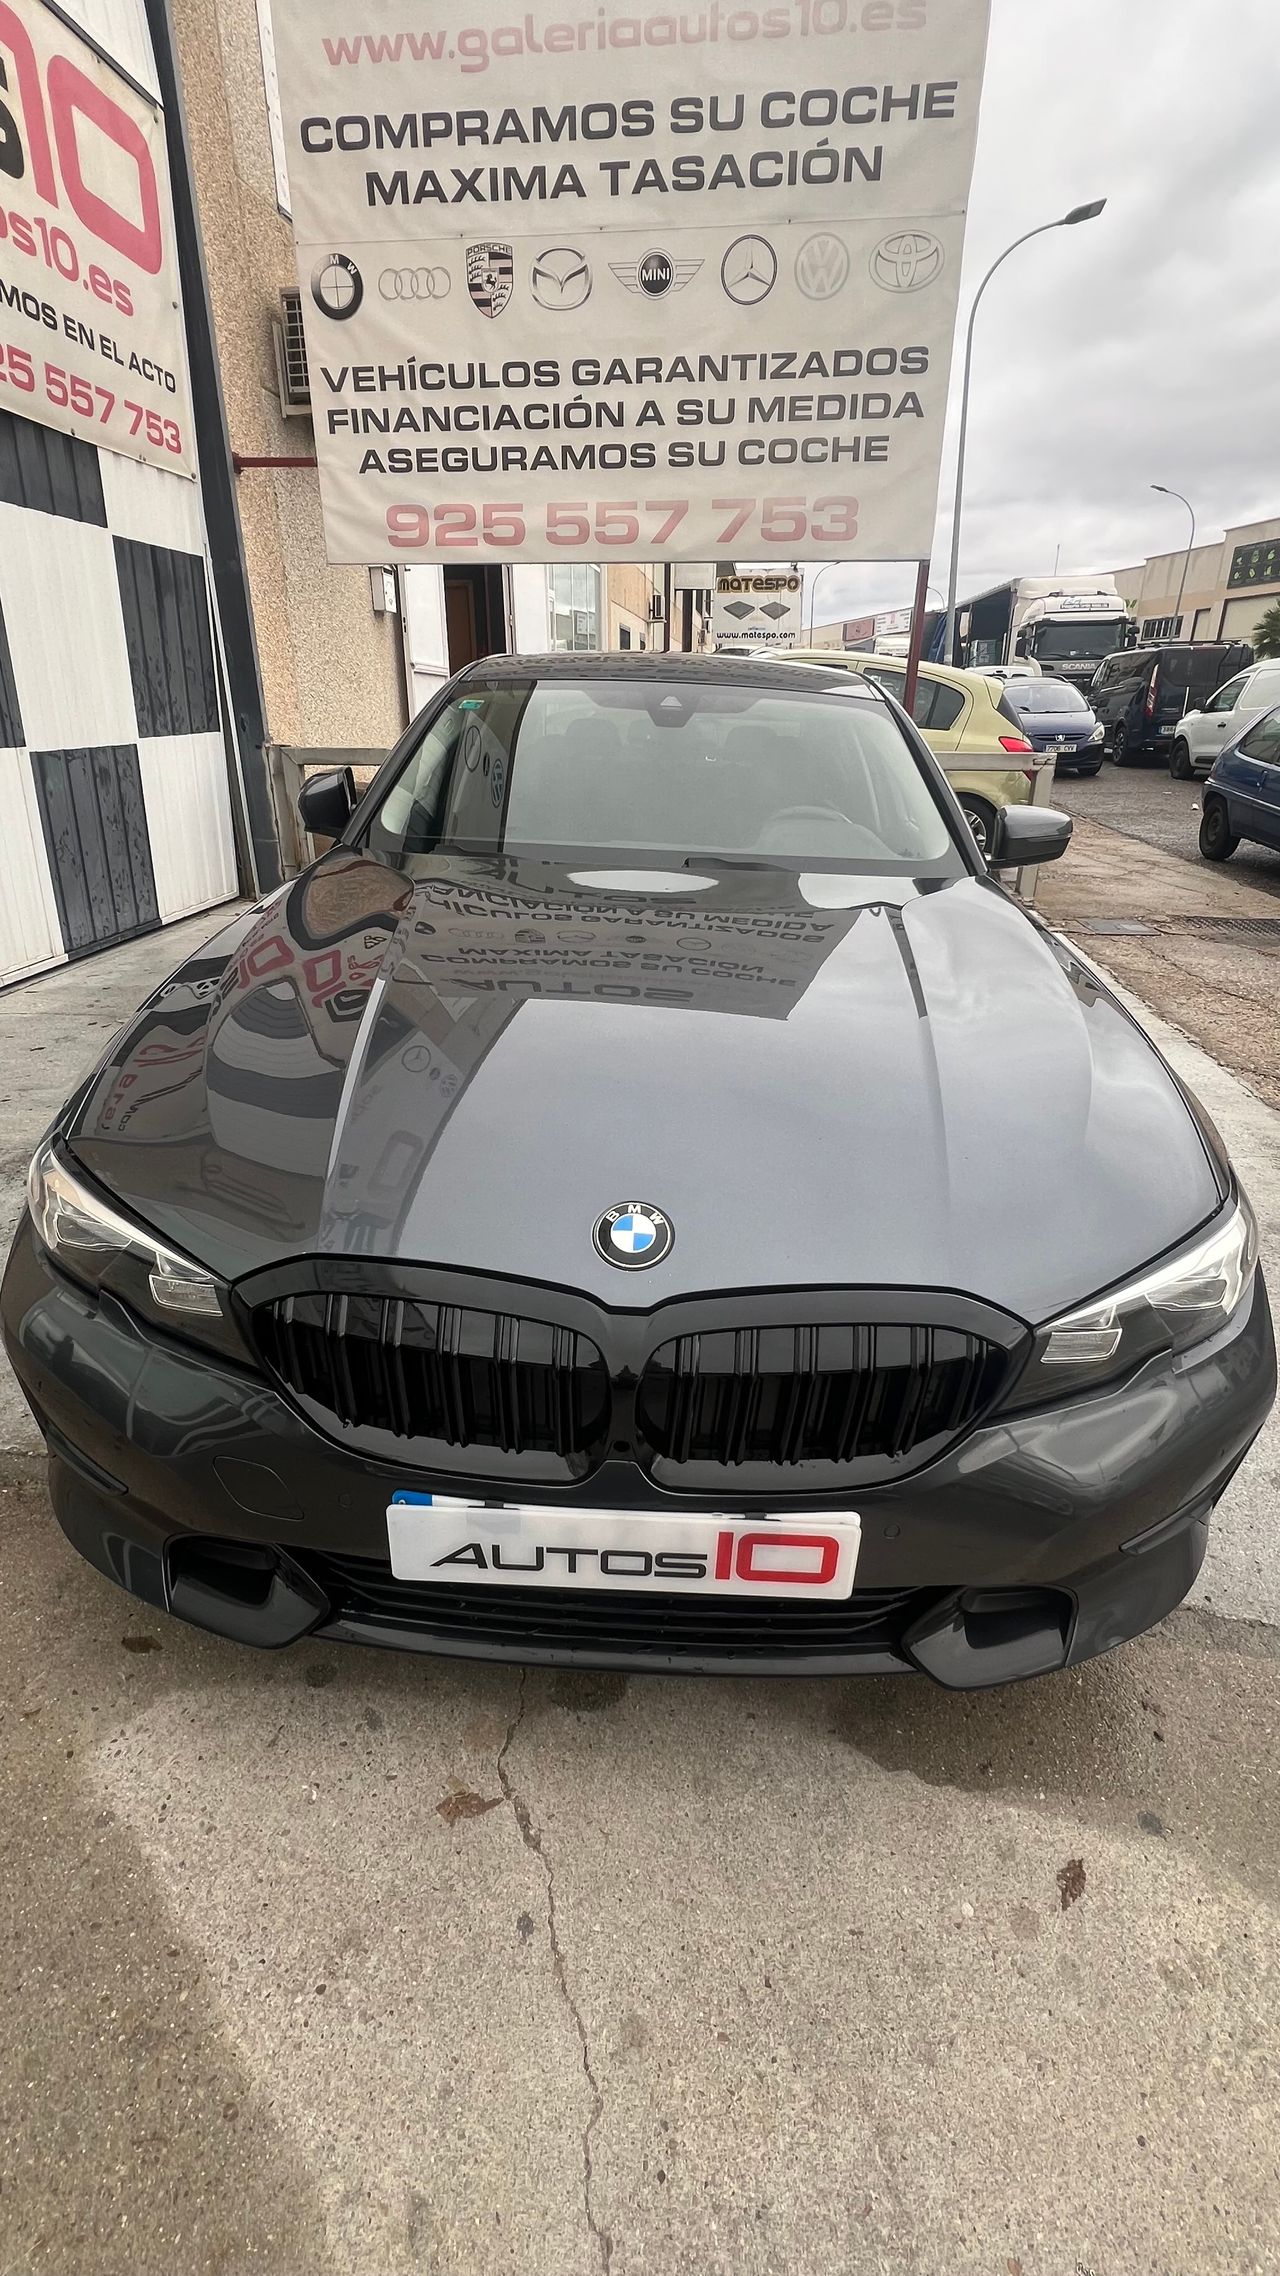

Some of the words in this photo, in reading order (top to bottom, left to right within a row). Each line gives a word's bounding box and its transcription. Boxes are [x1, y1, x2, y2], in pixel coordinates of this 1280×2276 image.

[321, 0, 928, 73] www.galeriaautos10.es
[300, 100, 655, 153] COMPRAMOS
[670, 94, 744, 133] SU
[760, 81, 958, 128] COCHE
[366, 164, 587, 206] MAXIMA
[600, 137, 883, 196] TASACIÓN
[467, 244, 512, 256] PORSCHE
[642, 267, 670, 281] MINI
[63, 314, 95, 351] EN
[99, 334, 124, 366] EL
[129, 351, 176, 393] ACTO
[320, 356, 560, 393] VEHÍCULOS
[572, 346, 929, 386] GARANTIZADOS
[44, 362, 116, 424] 557
[124, 400, 182, 454] 753
[327, 395, 624, 434] FINANCIACIÓN
[635, 400, 665, 426] A
[677, 398, 735, 425] SU
[748, 391, 924, 423] MEDIDA
[359, 443, 656, 474] ASEGURAMOS
[668, 441, 726, 467] SU
[738, 435, 890, 465] COCHE
[386, 503, 526, 548] 925
[545, 500, 689, 546] 557
[711, 496, 859, 544] 753
[716, 631, 796, 640] www.matespo.com
[1062, 663, 1096, 671] SCANIA
[606, 1204, 664, 1225] BMW
[429, 1531, 840, 1584] AUTOS10
